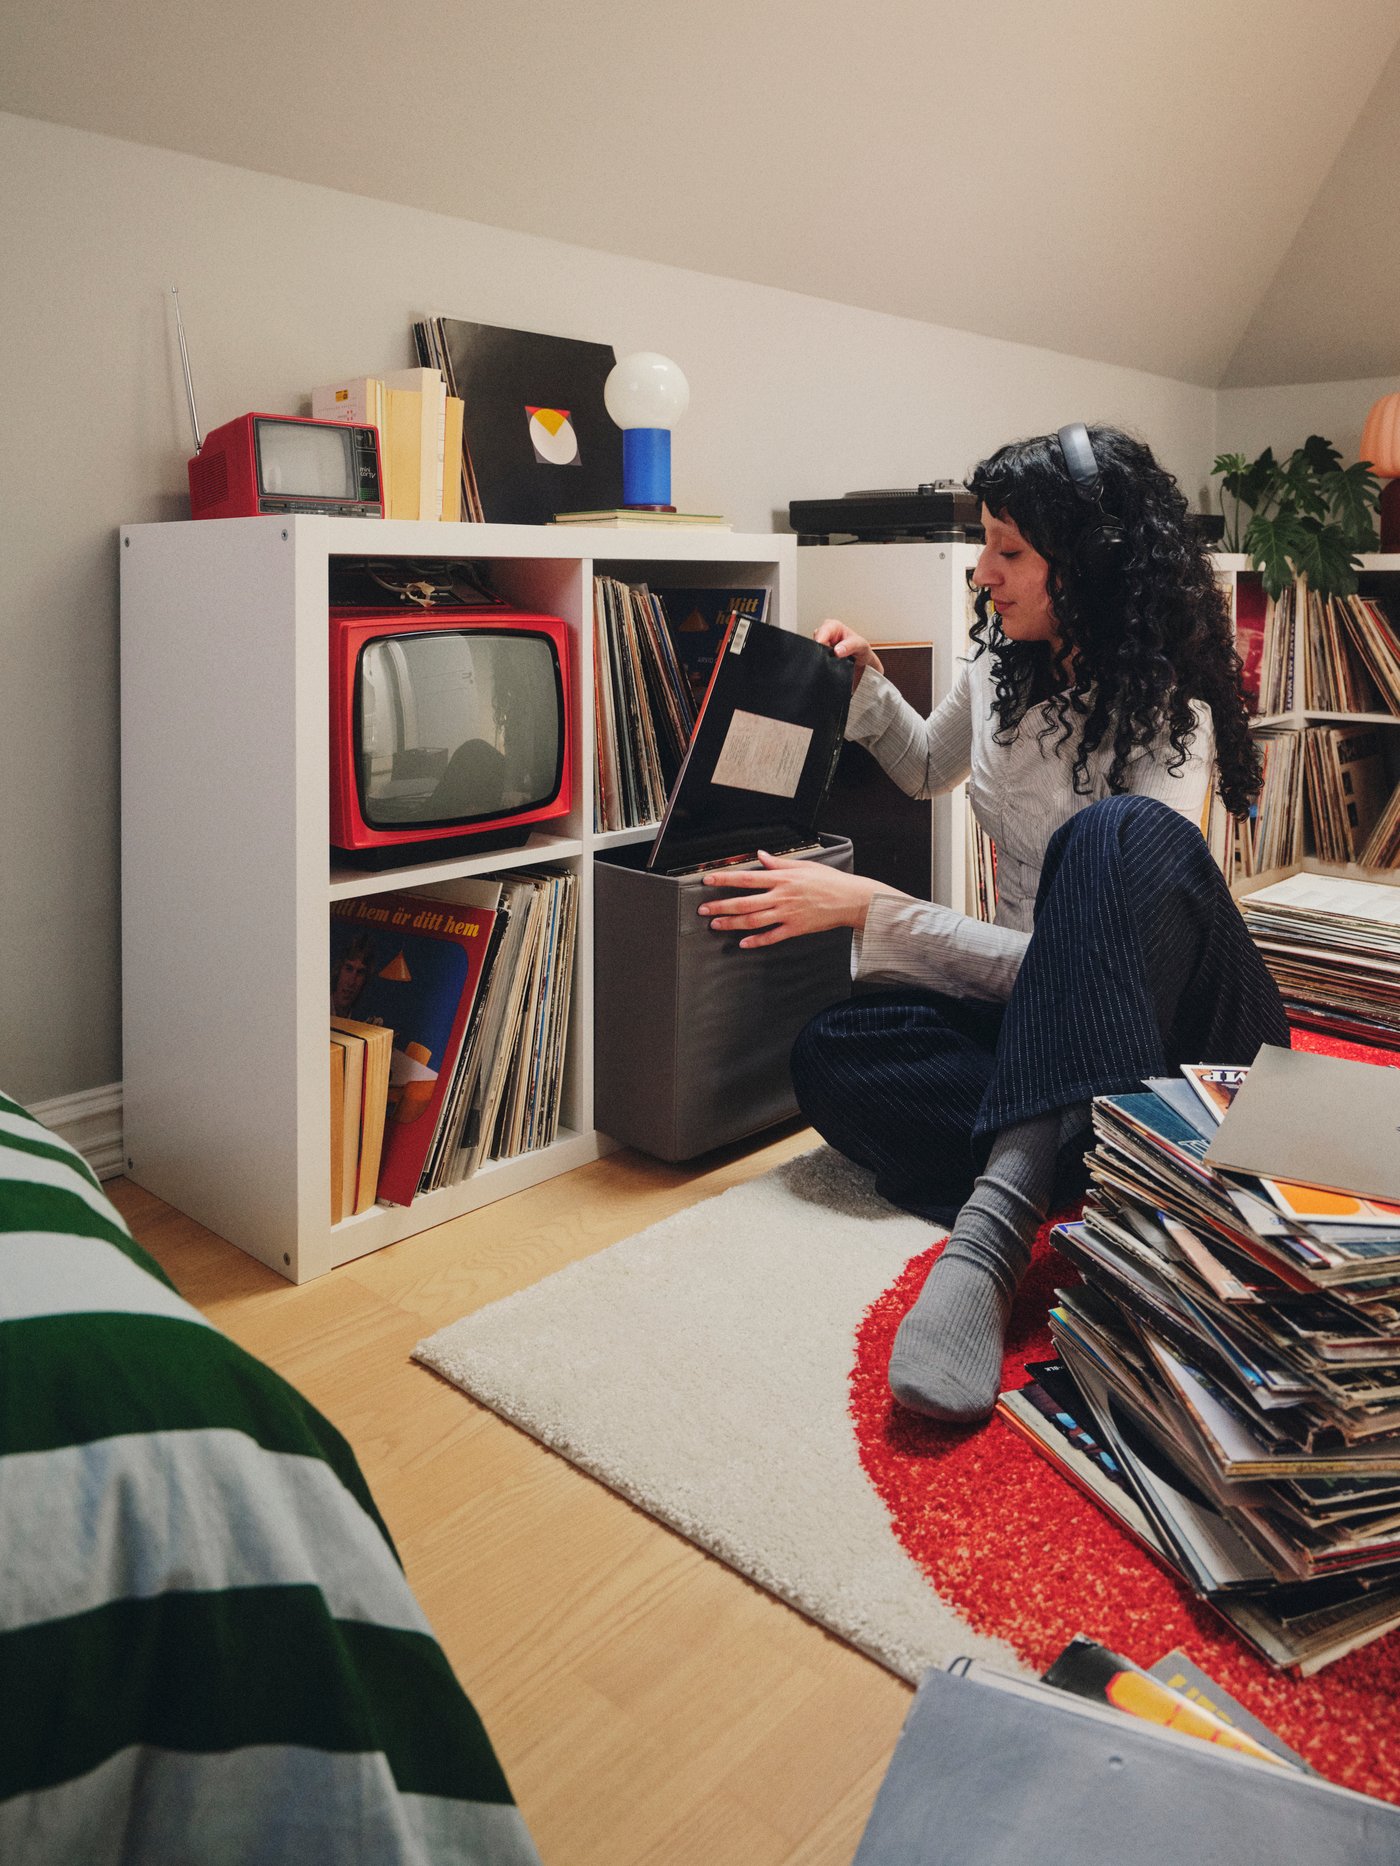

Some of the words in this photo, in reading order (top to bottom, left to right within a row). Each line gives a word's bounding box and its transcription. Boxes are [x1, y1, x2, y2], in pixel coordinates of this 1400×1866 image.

[357, 901, 390, 923] hem
[392, 907, 411, 926] är
[412, 911, 444, 931] ditt
[444, 915, 480, 938] hem
